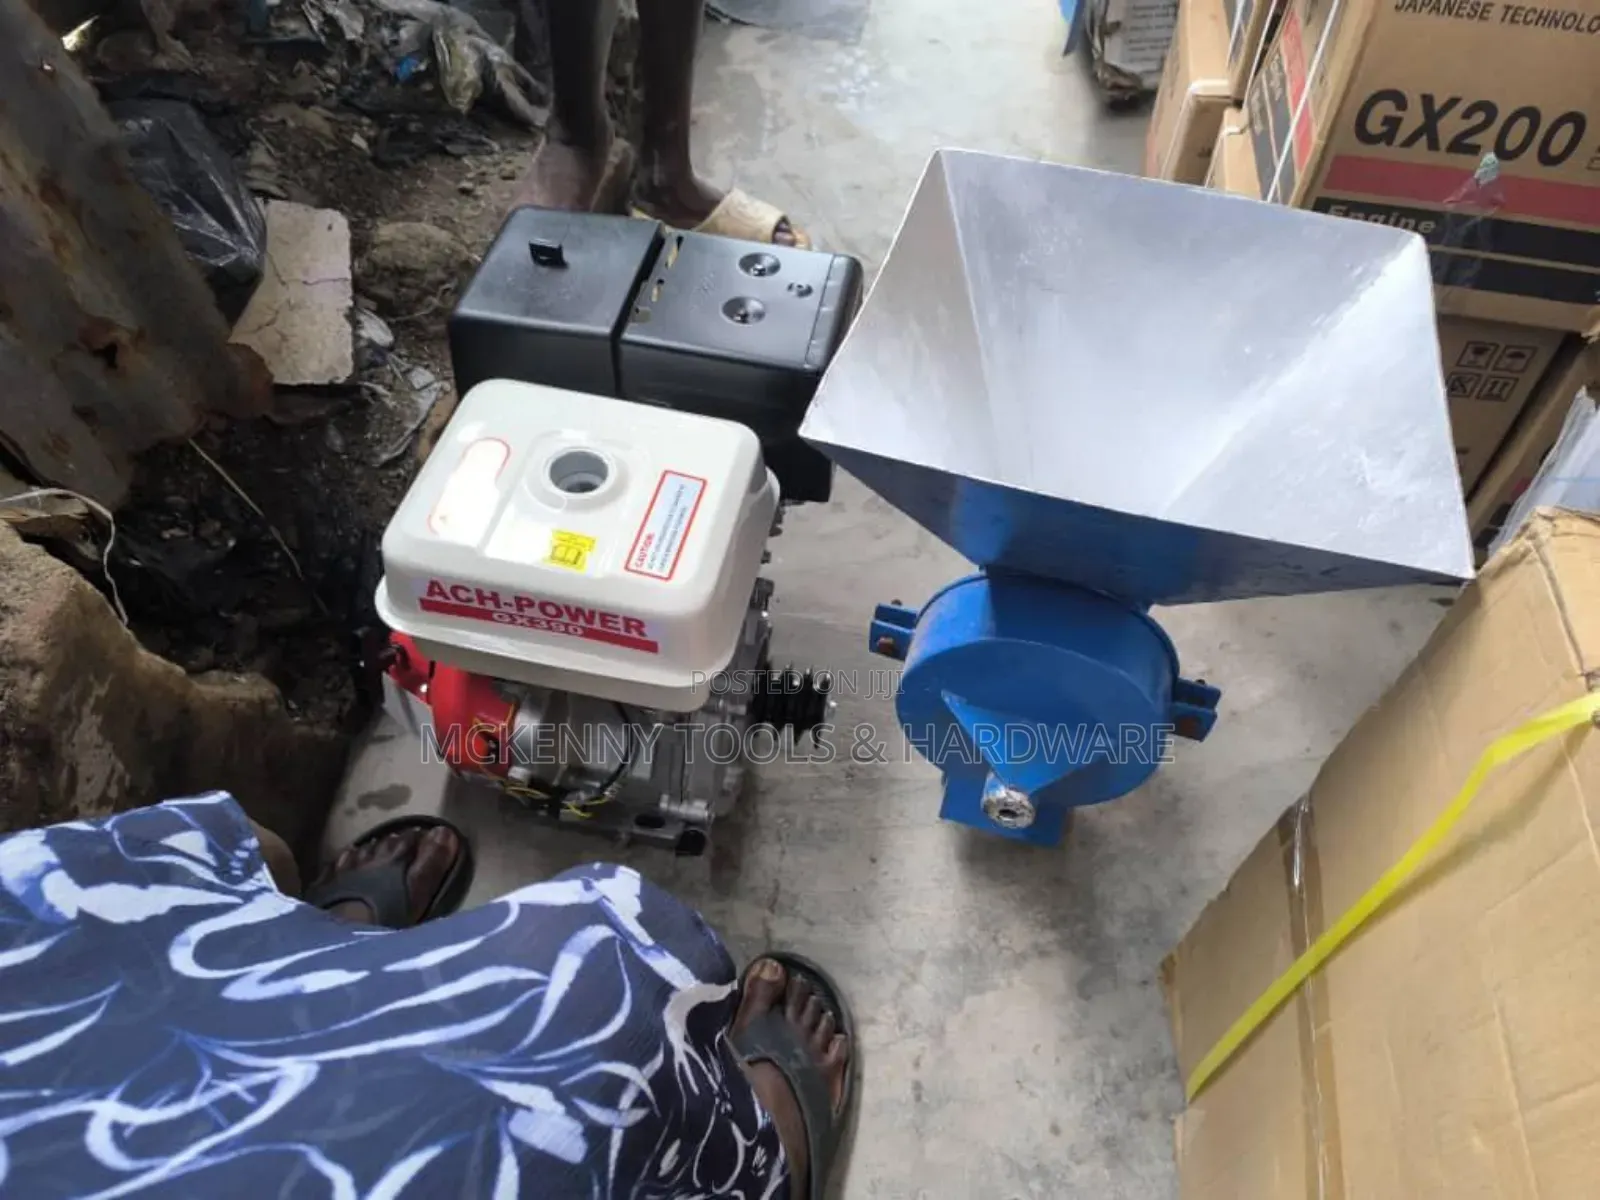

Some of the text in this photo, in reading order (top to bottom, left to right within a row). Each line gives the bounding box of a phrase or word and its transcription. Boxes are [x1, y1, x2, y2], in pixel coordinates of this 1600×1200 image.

[1354, 88, 1587, 167] GX200
[426, 579, 648, 637] ACH-POWER
[492, 611, 585, 636] GX390
